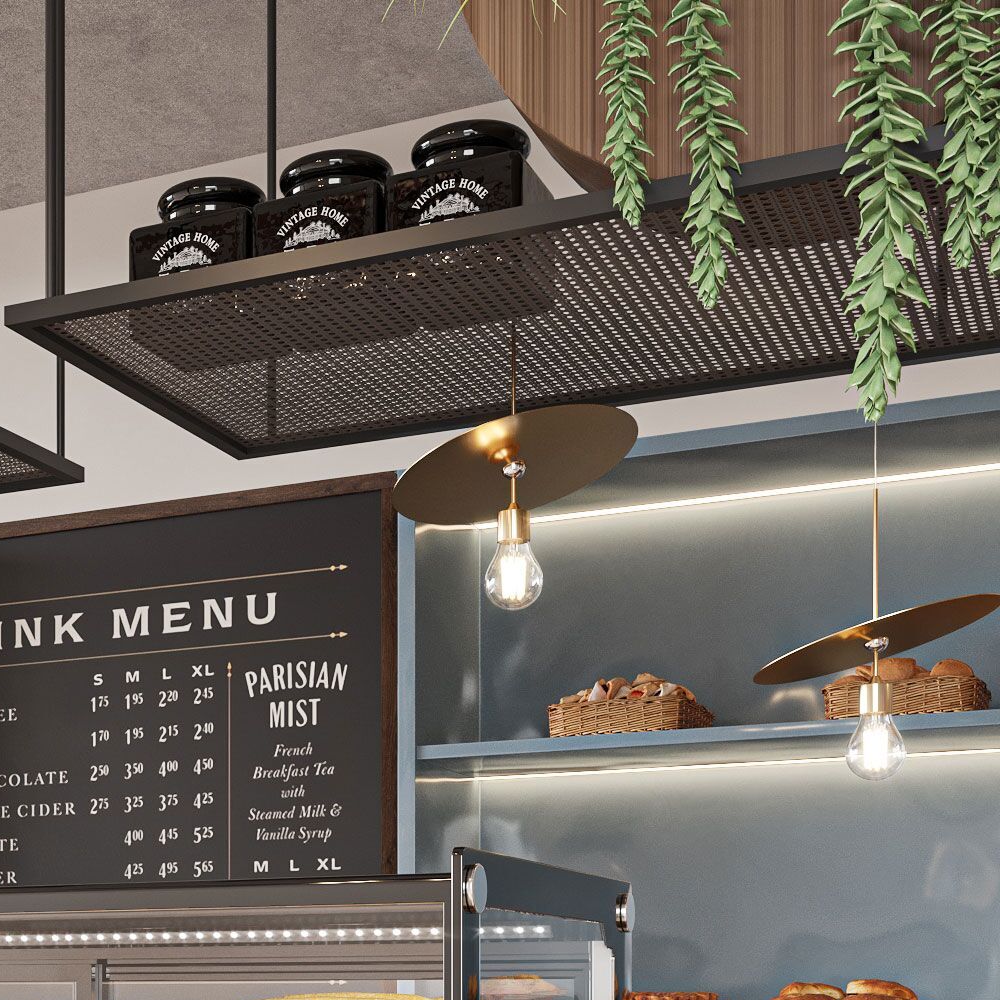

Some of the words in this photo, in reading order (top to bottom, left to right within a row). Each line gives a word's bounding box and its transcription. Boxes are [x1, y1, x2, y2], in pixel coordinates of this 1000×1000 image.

[411, 178, 456, 212] VINTAGE
[459, 178, 490, 200] HOME
[276, 206, 319, 239] VINTAGE
[321, 206, 349, 228] HOME
[151, 232, 192, 262] VINTAGE
[194, 232, 220, 253] HOME
[112, 592, 279, 639] MENU
[93, 673, 104, 686] S
[125, 670, 140, 683] M
[162, 668, 172, 680] L
[191, 665, 214, 678] XL
[245, 661, 348, 698] PARISIAN
[269, 698, 321, 728] MIST
[274, 742, 313, 758] French
[252, 765, 309, 782] Breakfast
[313, 760, 335, 775] Tea
[281, 785, 305, 799] with
[17, 802, 76, 818] CIDER
[248, 806, 295, 821] Steamed
[299, 803, 328, 819] Milk
[329, 803, 342, 817] &
[255, 826, 295, 841] Vanilla
[298, 826, 332, 844] Syrup
[253, 860, 269, 873] M
[289, 858, 300, 872] L
[317, 858, 342, 871] XL
